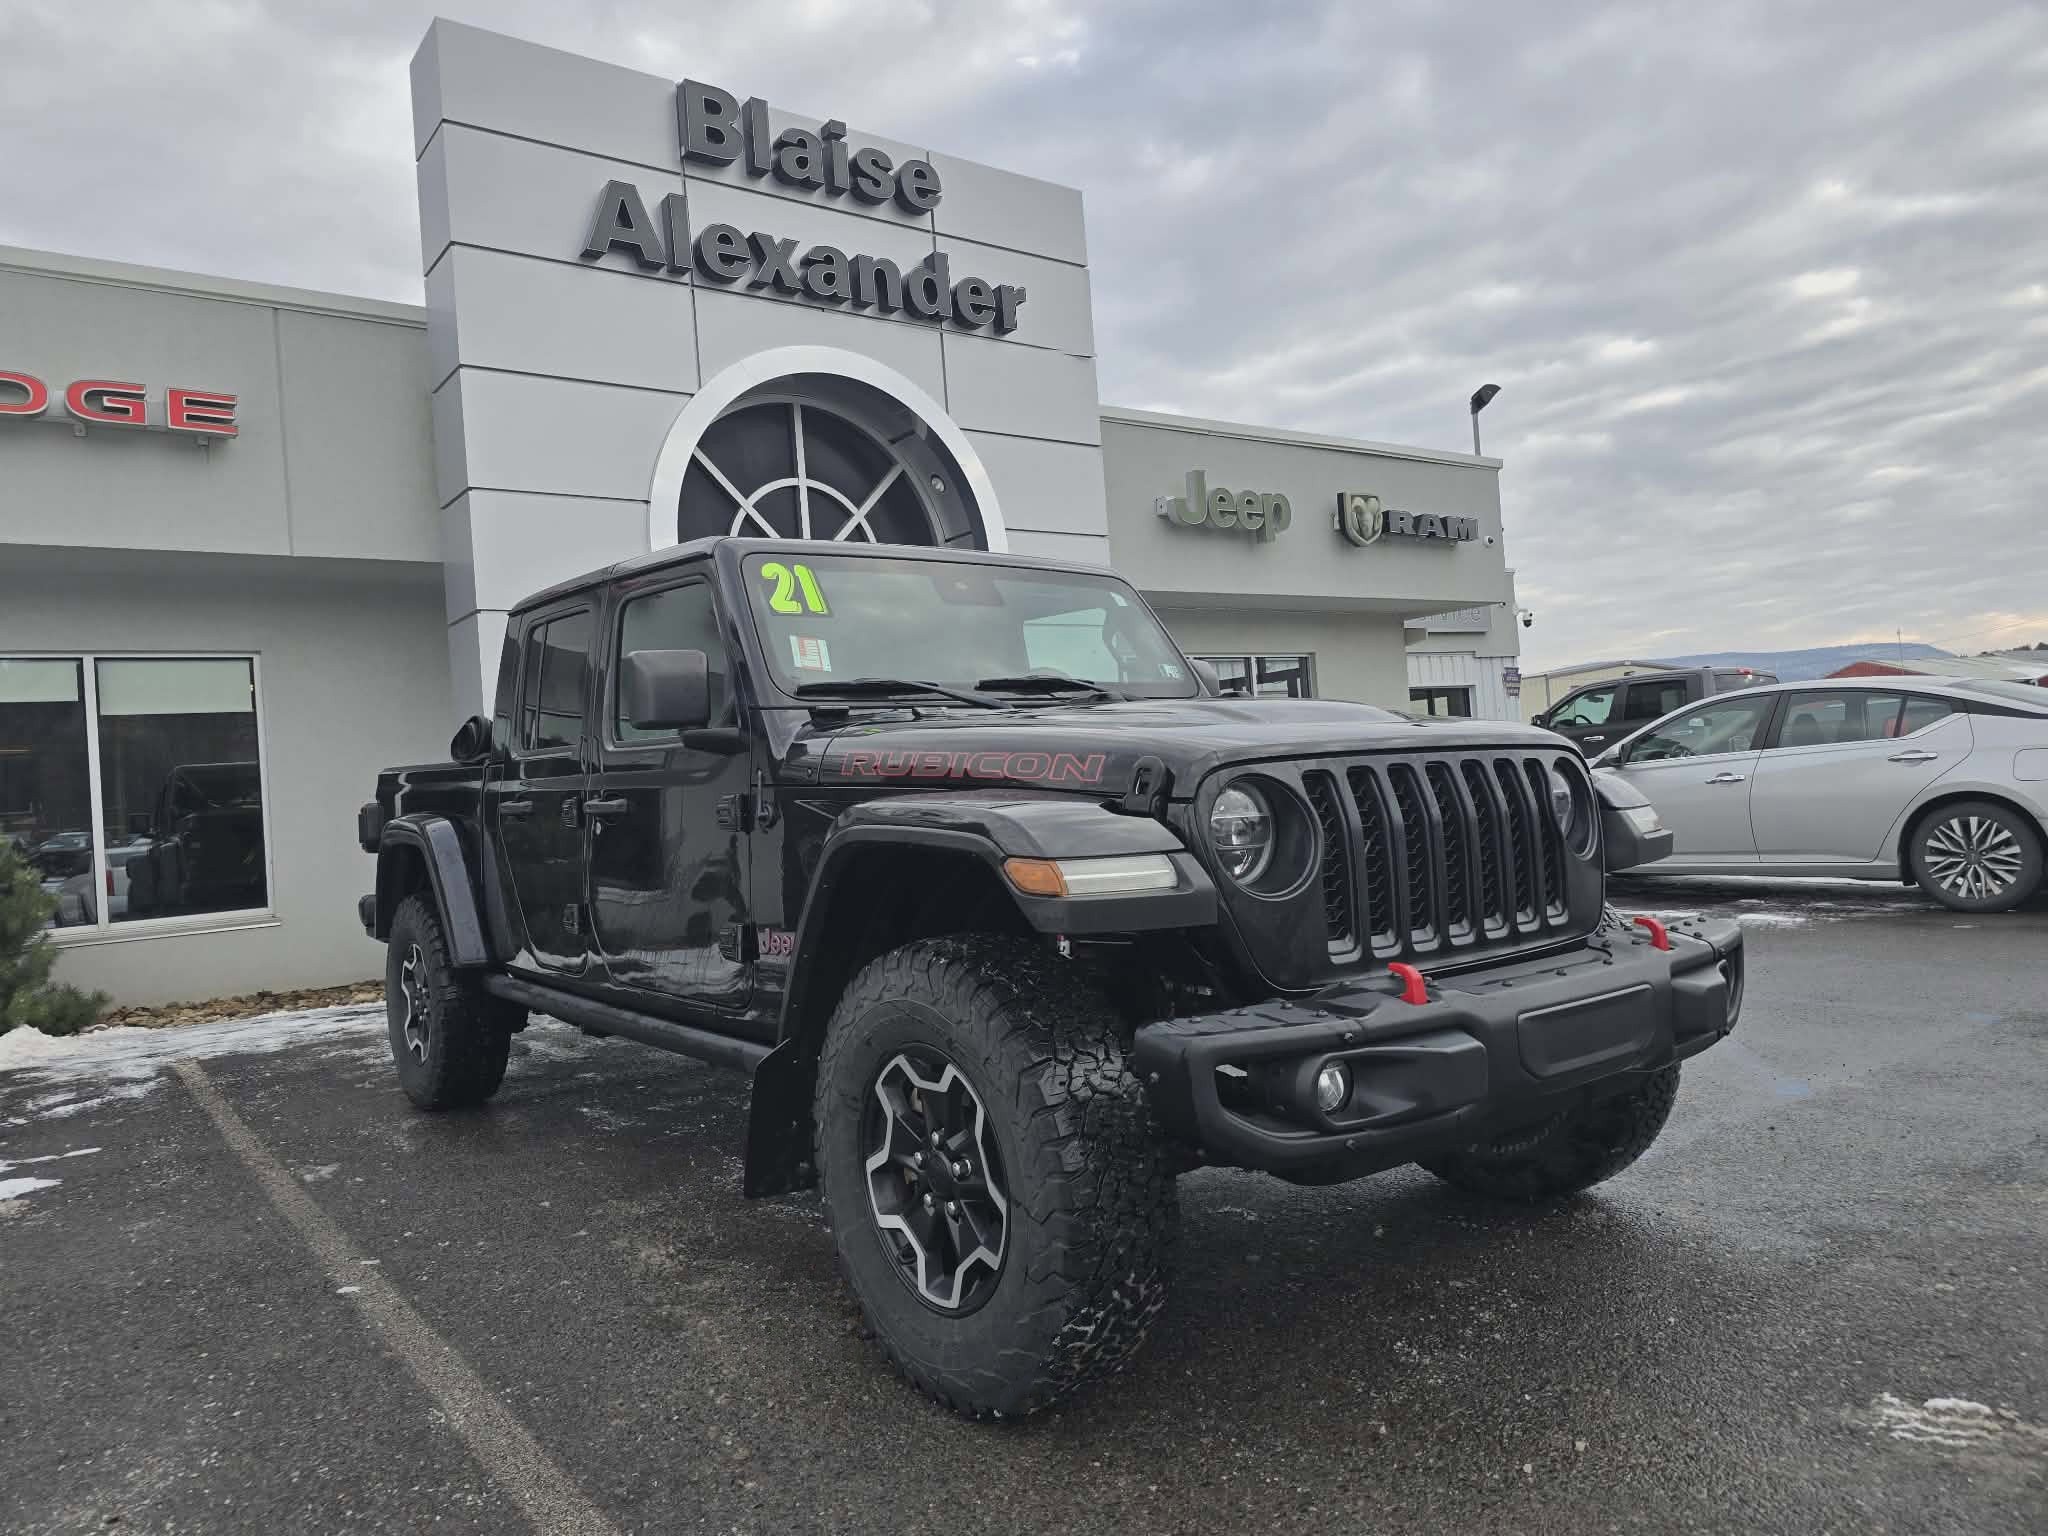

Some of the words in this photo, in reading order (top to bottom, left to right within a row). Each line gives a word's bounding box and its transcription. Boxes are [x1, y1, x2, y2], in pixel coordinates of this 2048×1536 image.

[676, 78, 943, 215] Blaise
[580, 179, 1027, 335] Alexander
[1166, 469, 1292, 544] Jeep
[1381, 509, 1479, 541] RAM
[761, 562, 828, 614] 21
[839, 751, 1106, 783] RUBICON
[758, 928, 796, 956] Jee
